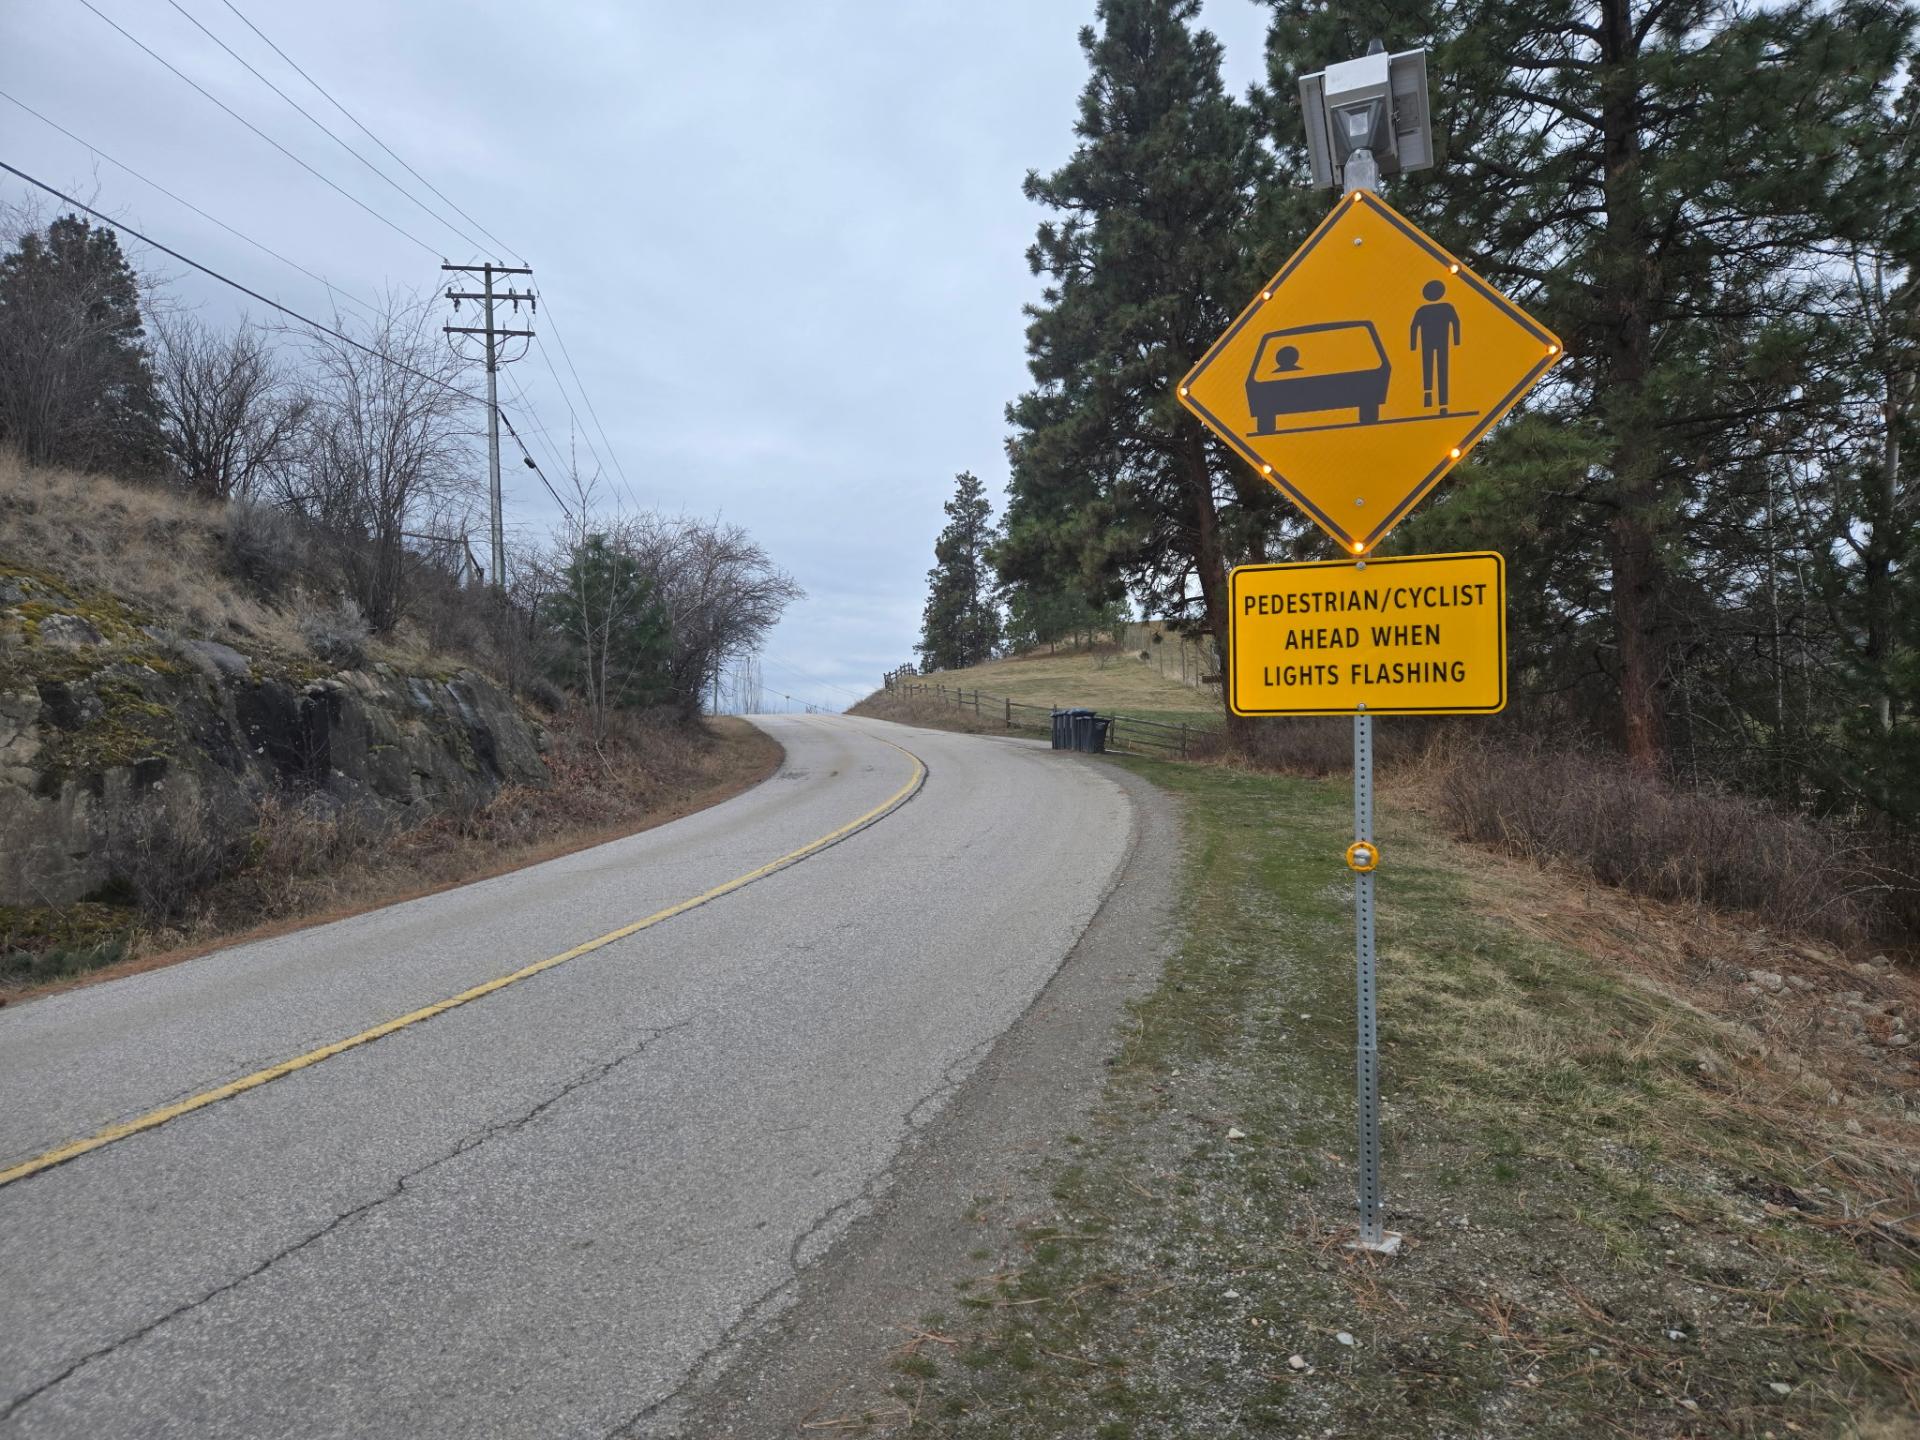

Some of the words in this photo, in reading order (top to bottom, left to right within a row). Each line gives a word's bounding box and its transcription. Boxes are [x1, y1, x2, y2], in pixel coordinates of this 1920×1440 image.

[1244, 584, 1487, 616] PEDESTRIAN/CYCLIST
[1284, 627, 1360, 650] AHEAD
[1371, 624, 1441, 647] WHEN
[1264, 664, 1339, 687] LIGHTS
[1351, 660, 1466, 685] FLASHING
